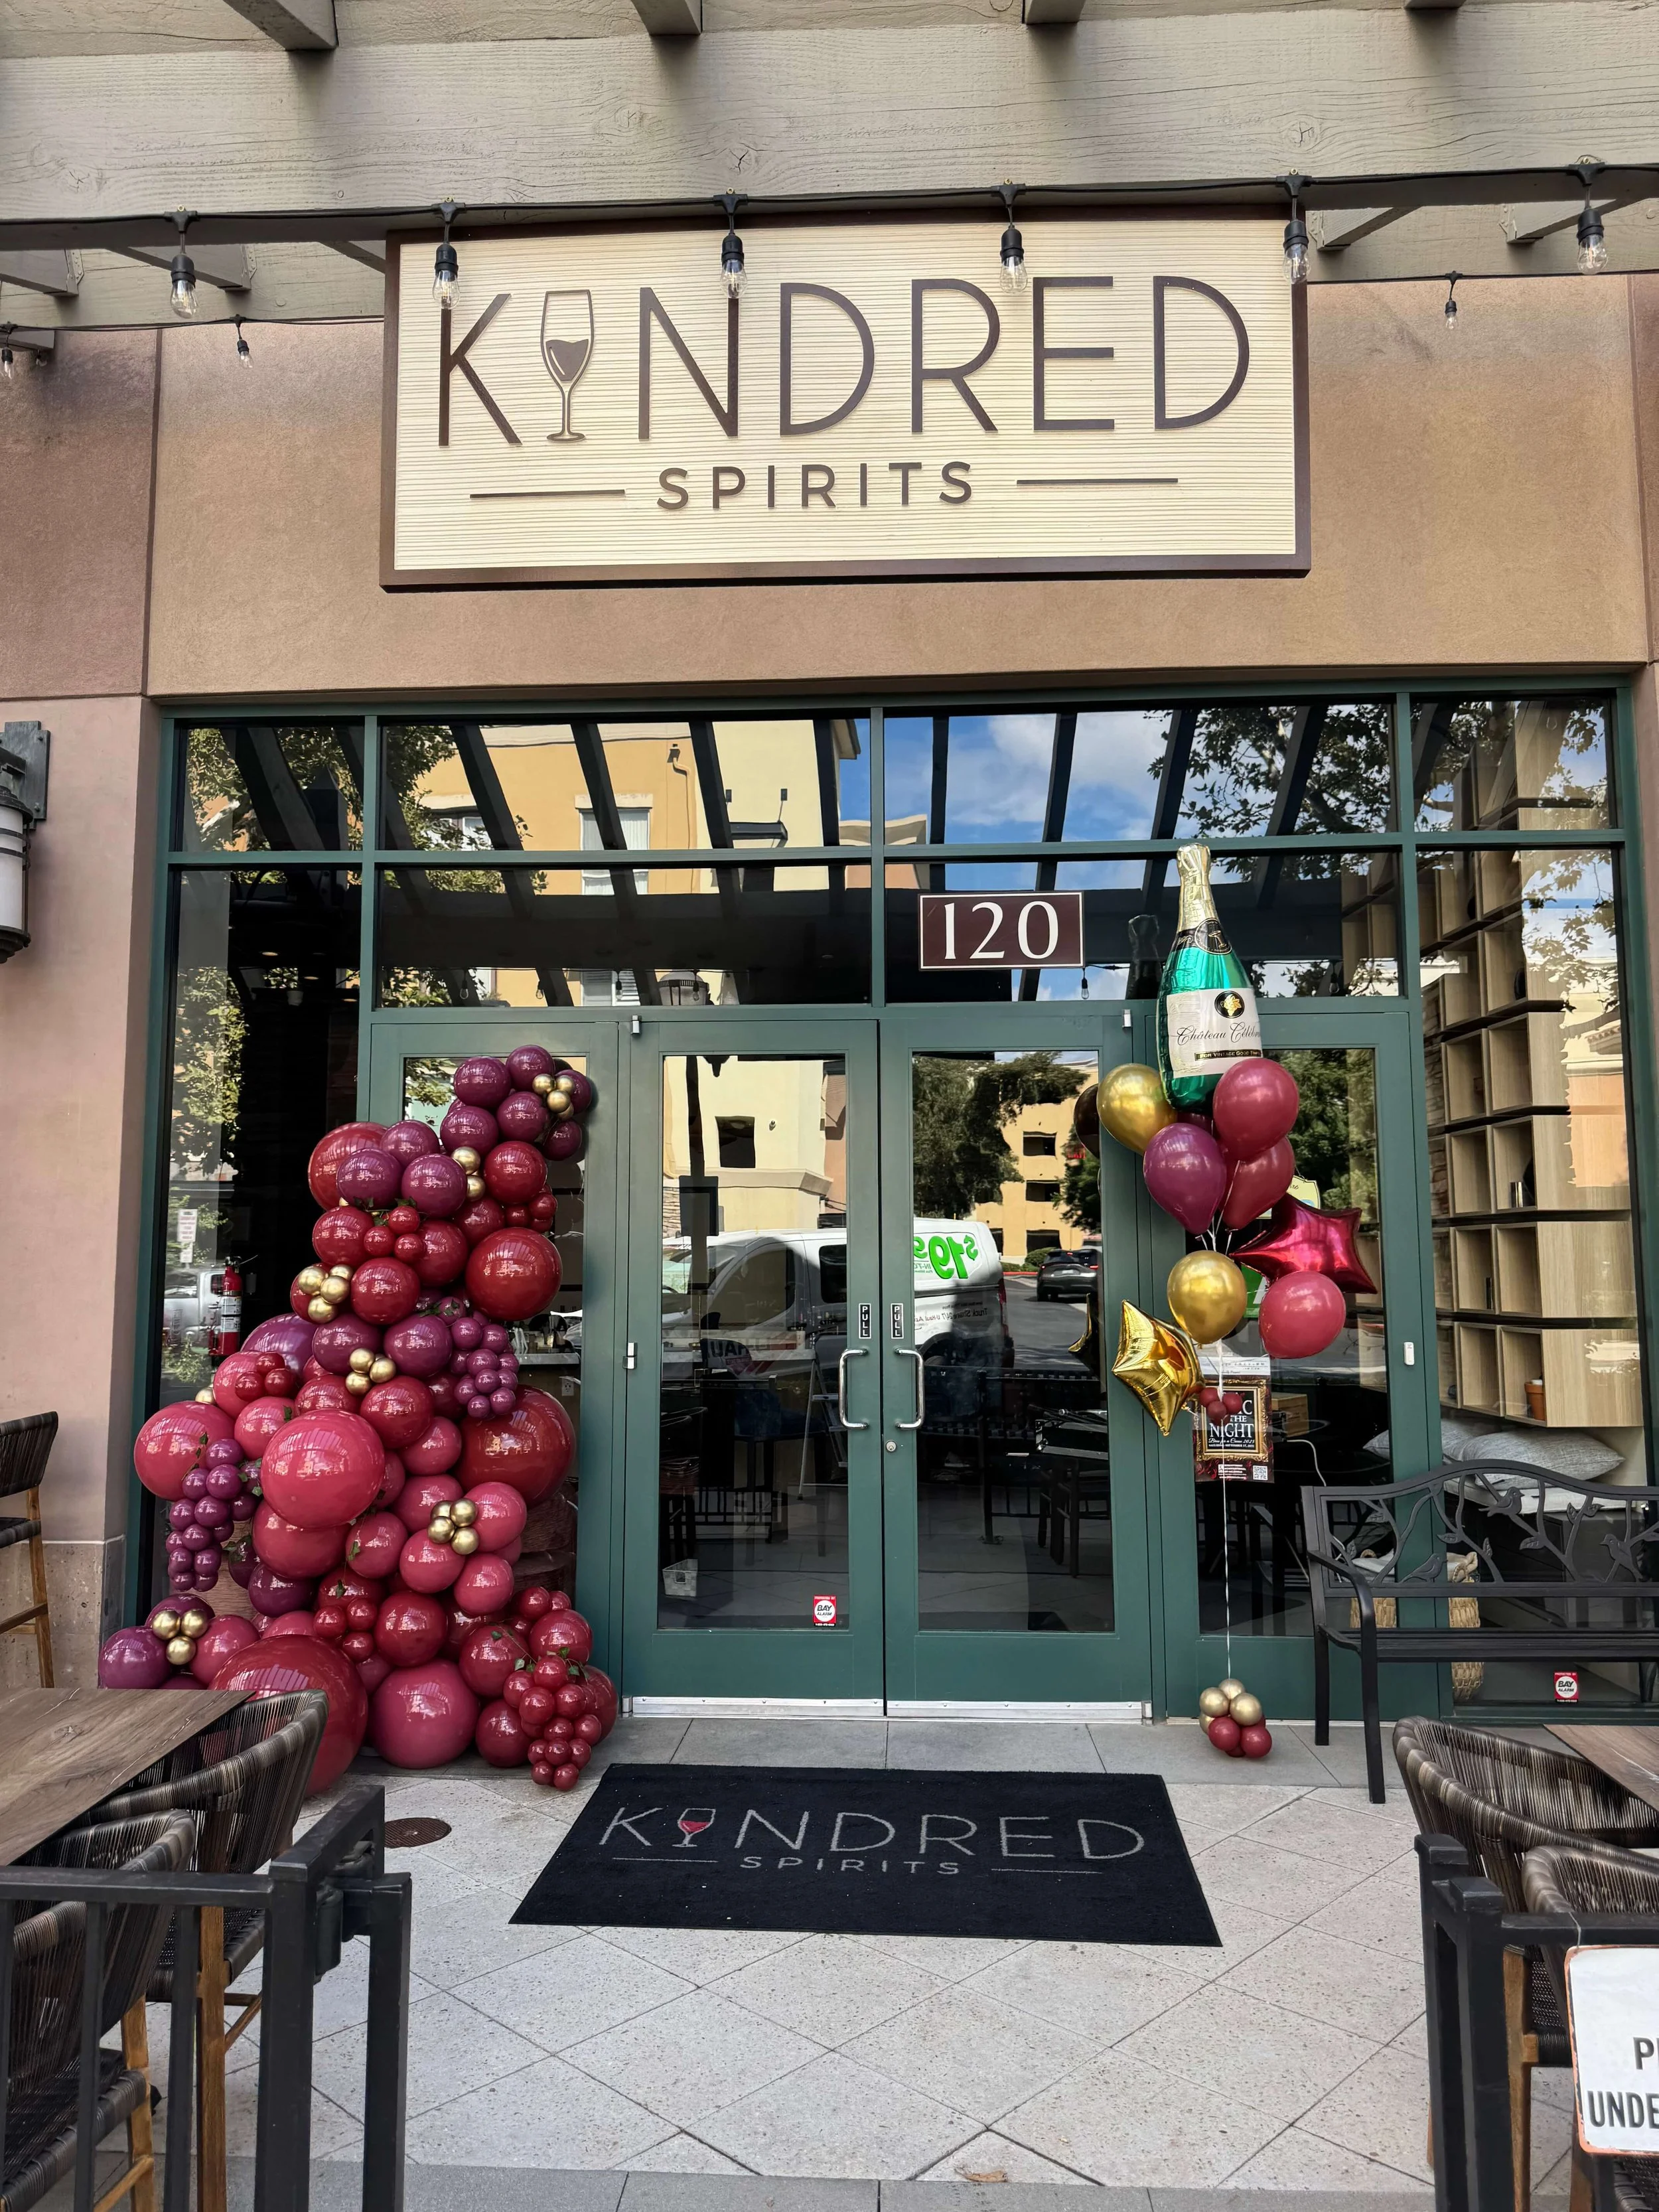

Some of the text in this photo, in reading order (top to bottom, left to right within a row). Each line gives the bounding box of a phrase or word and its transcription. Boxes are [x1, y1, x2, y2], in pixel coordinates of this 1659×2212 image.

[657, 461, 973, 510] SPIRITS
[944, 900, 1059, 960] 120
[1176, 1025, 1226, 1046] Château
[1209, 1423, 1254, 1438] NIGHT
[739, 1856, 960, 1875] SPIRITS
[1632, 2036, 1659, 2071] P
